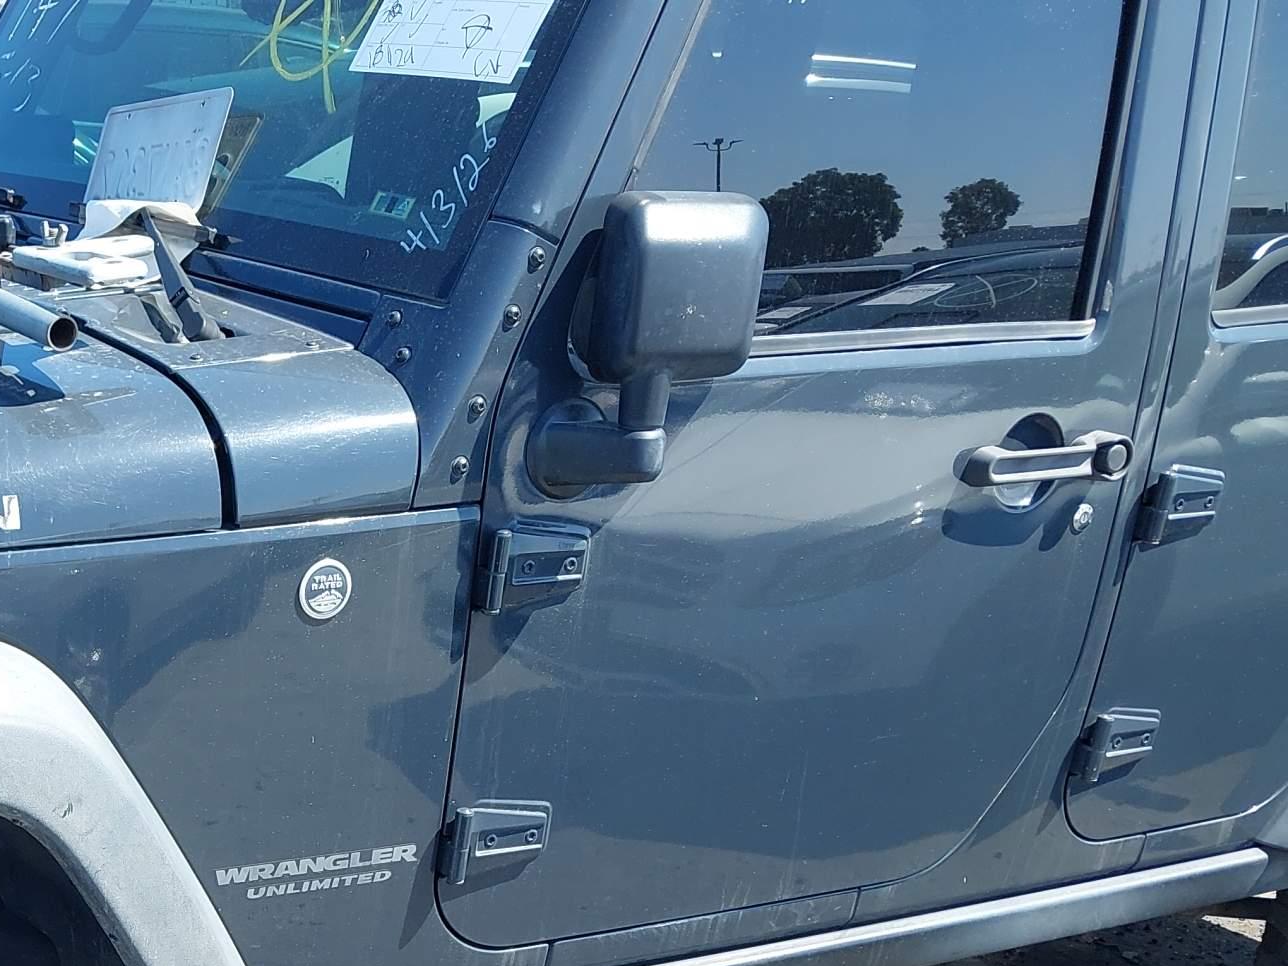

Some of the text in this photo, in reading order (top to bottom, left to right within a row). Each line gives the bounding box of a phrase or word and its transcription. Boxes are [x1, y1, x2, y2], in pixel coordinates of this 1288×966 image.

[311, 580, 343, 591] RATED
[313, 573, 342, 584] TRAIL
[215, 844, 418, 886] WRANGLER
[247, 870, 392, 899] UNLIMITED
